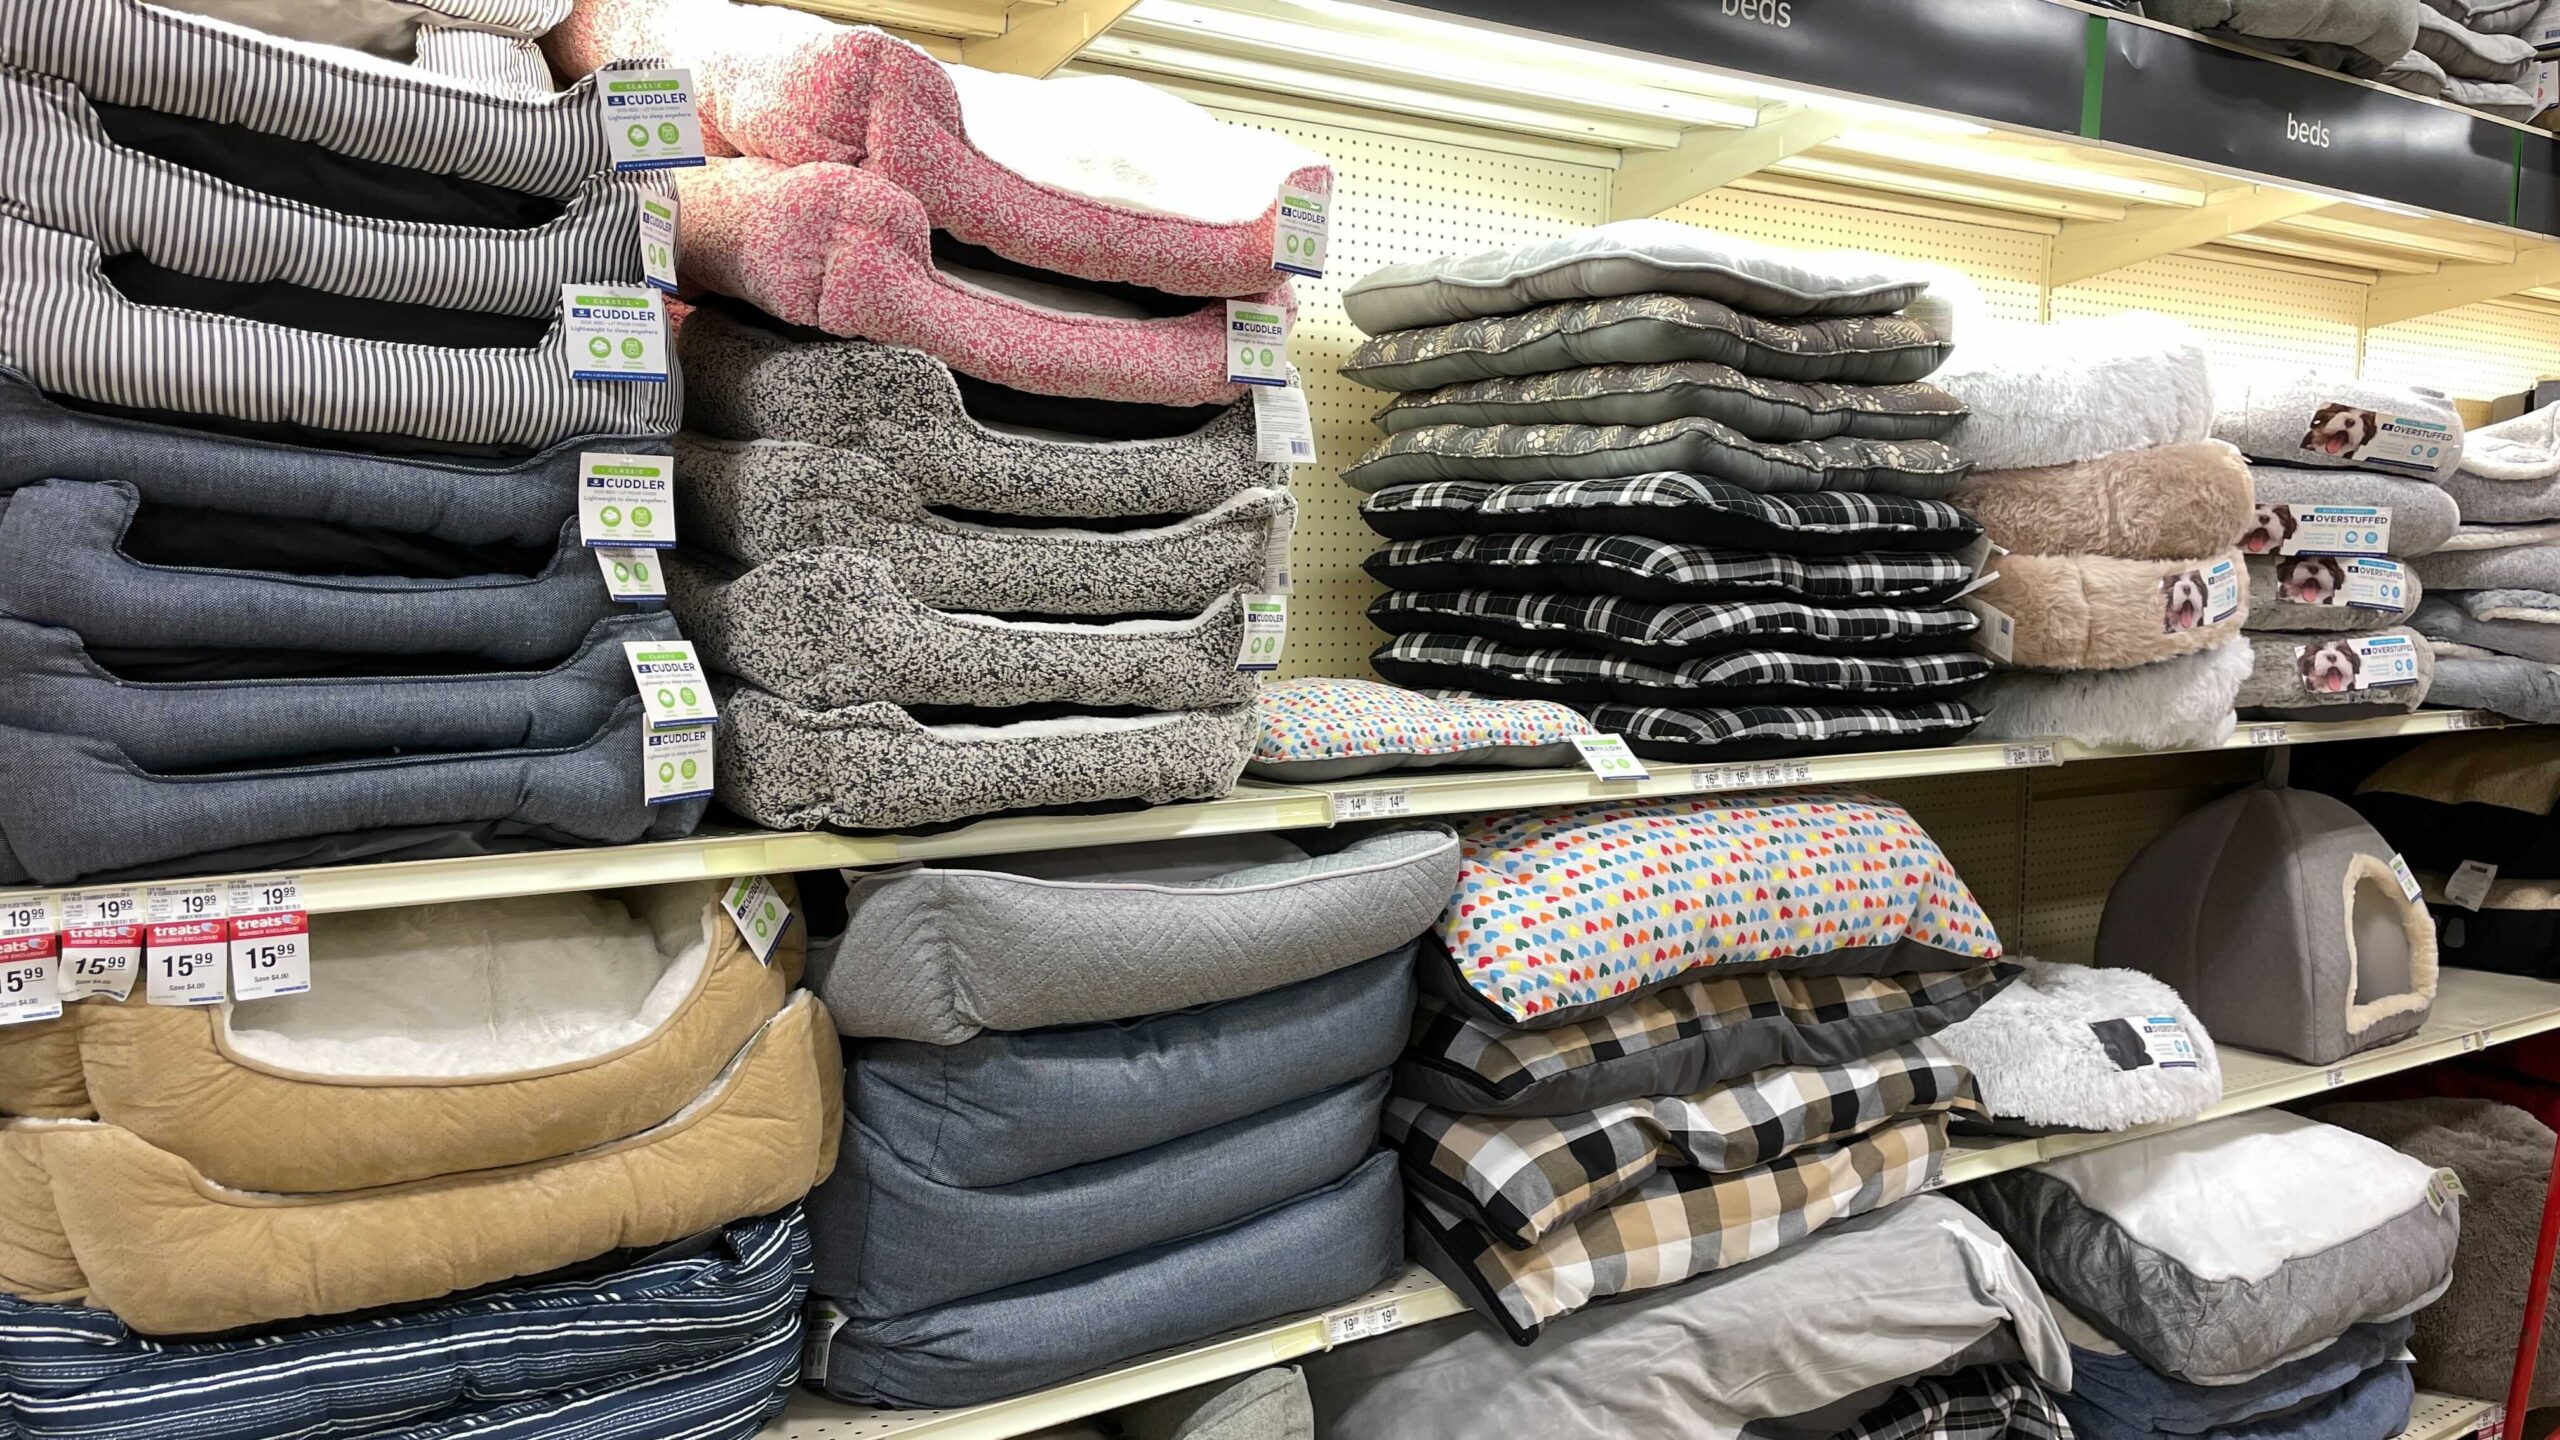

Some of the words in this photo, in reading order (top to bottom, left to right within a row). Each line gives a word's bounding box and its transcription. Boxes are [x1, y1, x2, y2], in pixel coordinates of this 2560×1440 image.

[1722, 0, 1791, 28] beds
[627, 93, 688, 105] CUDDLER
[2287, 112, 2329, 148] beds
[1292, 209, 1325, 224] CUDDLER
[649, 216, 672, 233] CUDDLER
[593, 298, 632, 306] CLASSIC
[593, 309, 656, 321] CUDDLER
[1244, 322, 1282, 335] CUDDLER
[2394, 425, 2453, 441] OVERSTUFFED
[608, 466, 644, 475] CLASSIC
[606, 478, 665, 490] CUDDLER
[2316, 515, 2388, 524] OVERSTUFFED
[2360, 567, 2403, 580] OVERSTUFFED
[1256, 613, 1284, 623] CUDDLER
[2372, 645, 2413, 654] OVERSTUFFED
[652, 663, 696, 673] CUDDLER
[662, 732, 706, 744] CUDDLER
[236, 917, 282, 930] treats
[69, 928, 117, 938] treats
[154, 925, 200, 936] treats
[266, 926, 300, 934] EXCLUSIVE!
